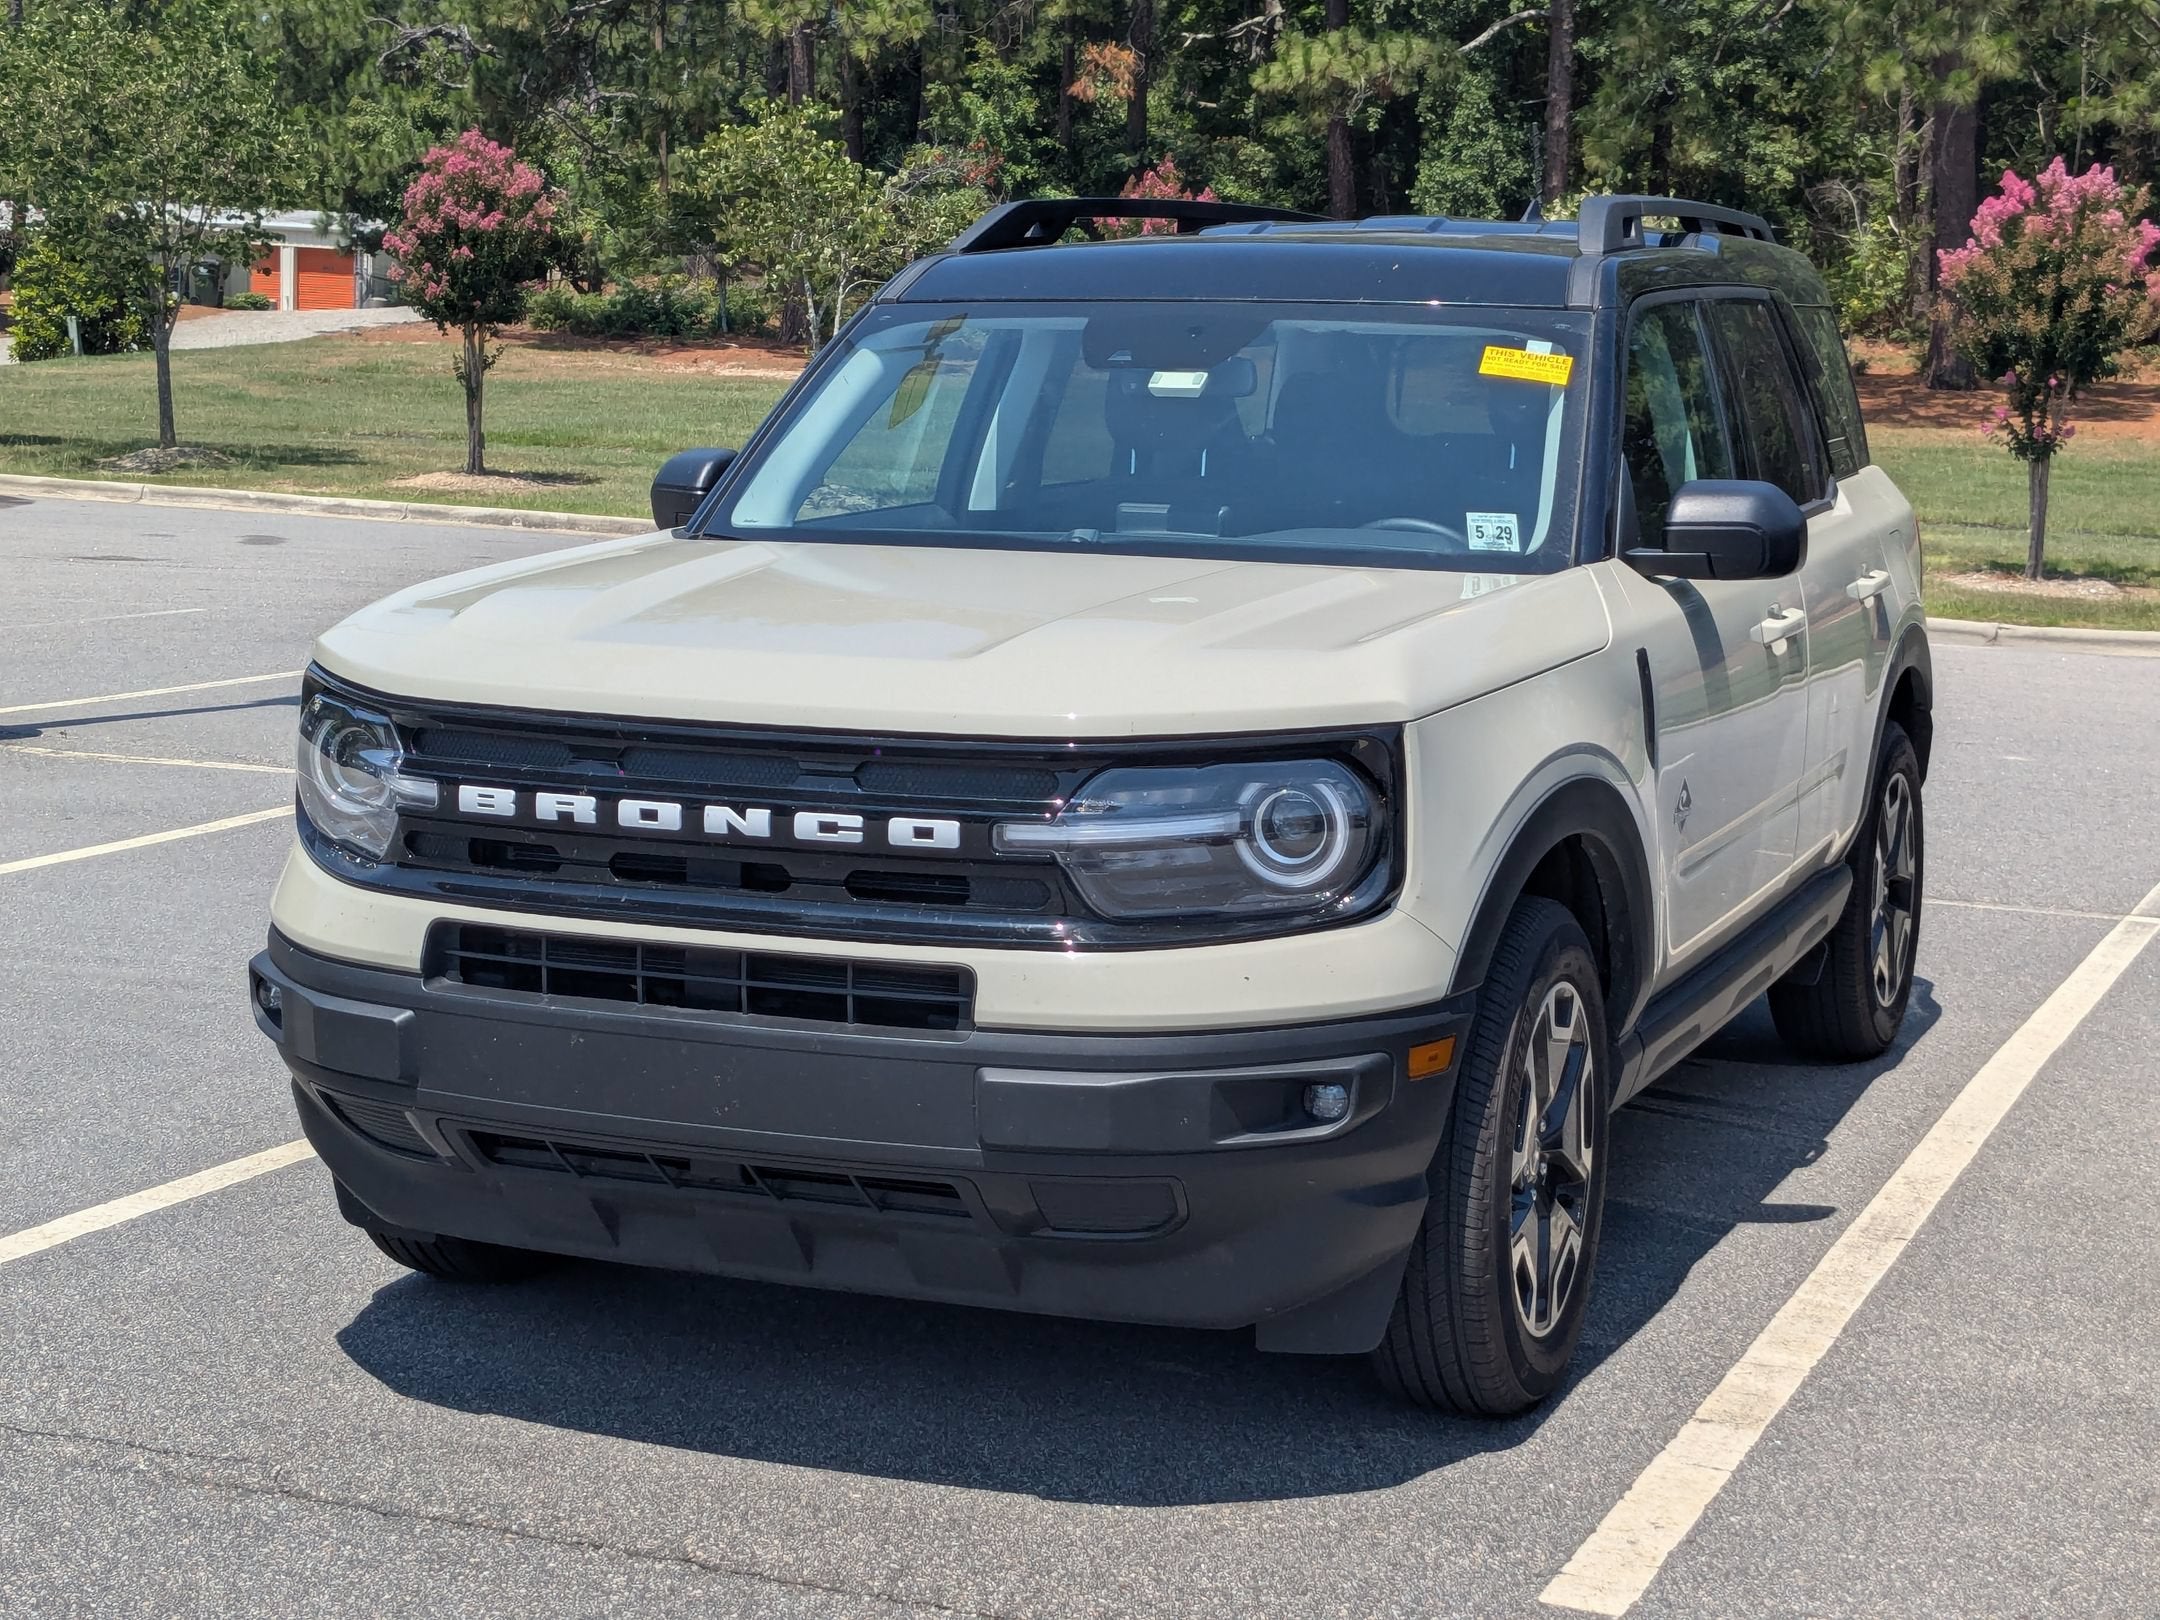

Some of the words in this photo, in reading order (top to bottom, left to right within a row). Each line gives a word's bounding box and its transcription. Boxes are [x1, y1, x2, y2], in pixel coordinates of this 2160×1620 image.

[1490, 348, 1515, 357] THIS
[1520, 353, 1568, 364] VEHICLE
[1549, 363, 1568, 371] SALE
[1475, 525, 1484, 539] 5
[1495, 526, 1512, 541] 29
[458, 785, 961, 849] BRONCO
